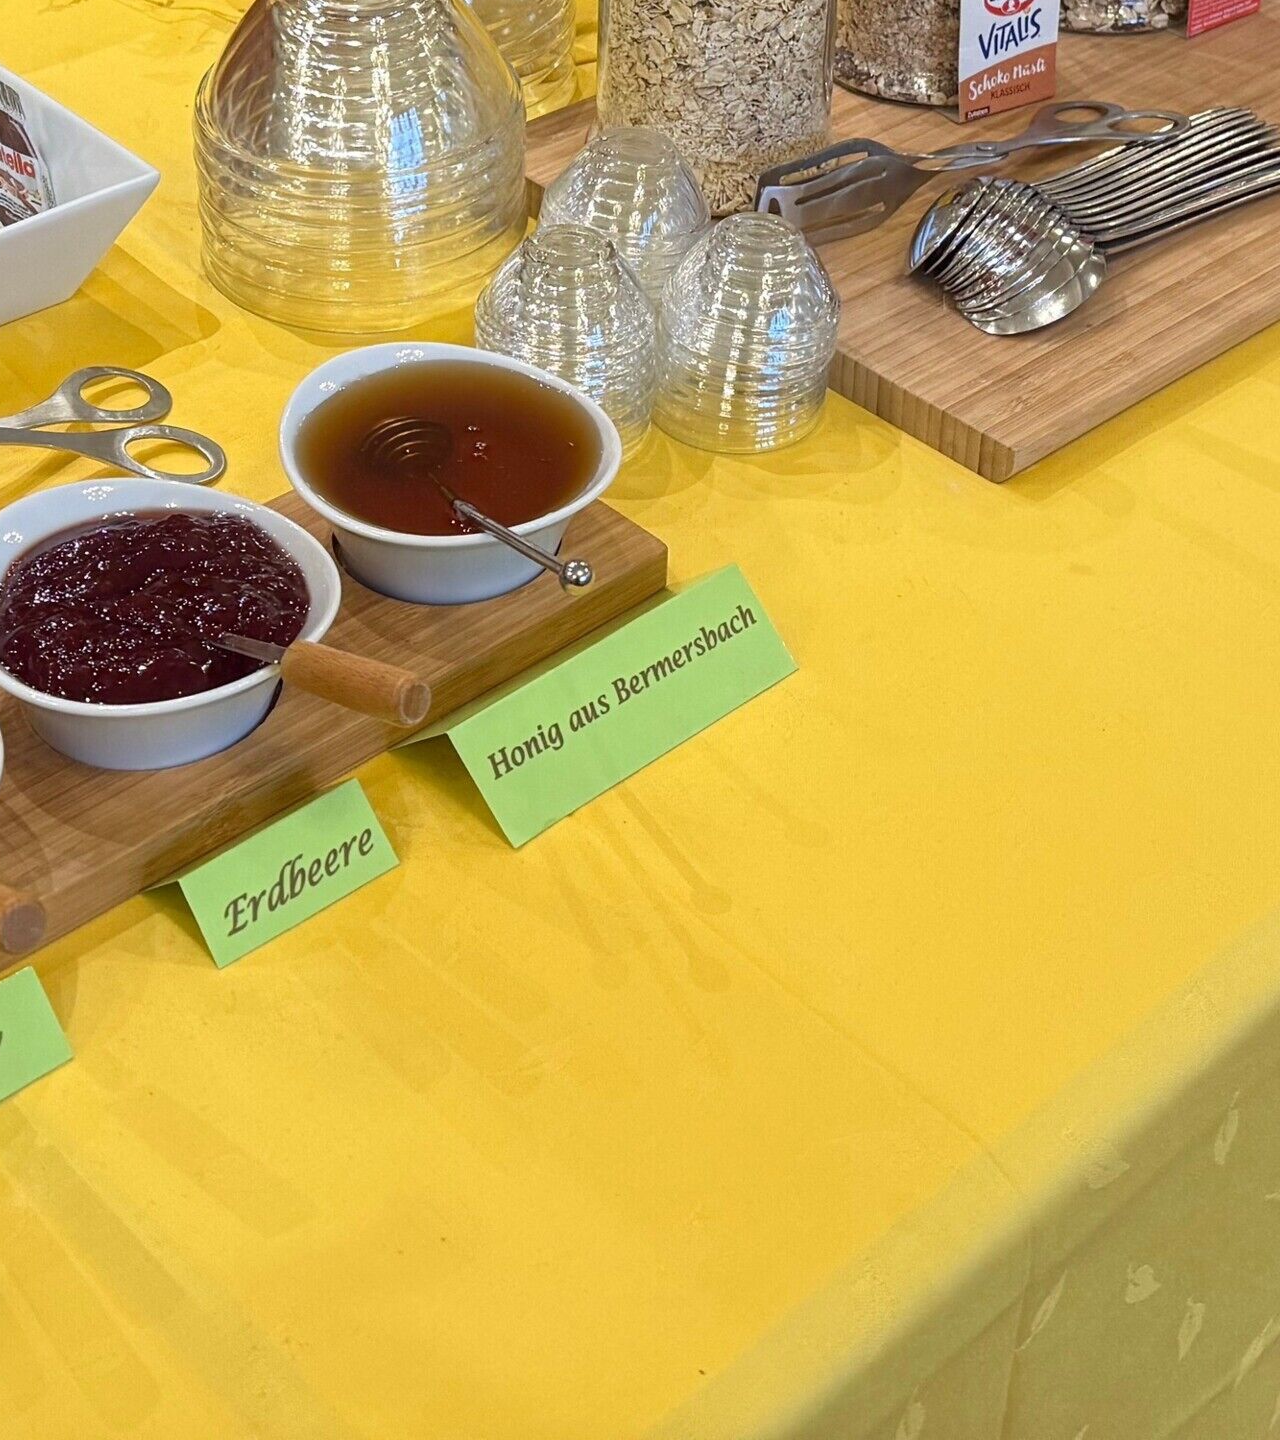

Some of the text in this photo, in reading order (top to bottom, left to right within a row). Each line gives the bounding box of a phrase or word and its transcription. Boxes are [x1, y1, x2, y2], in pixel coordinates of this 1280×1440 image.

[968, 58, 1047, 101] Schoko Müsli
[990, 81, 1031, 100] KLASSISCH
[486, 604, 758, 781] Honig aus Bermersbach
[223, 827, 374, 938] Erdbeere
